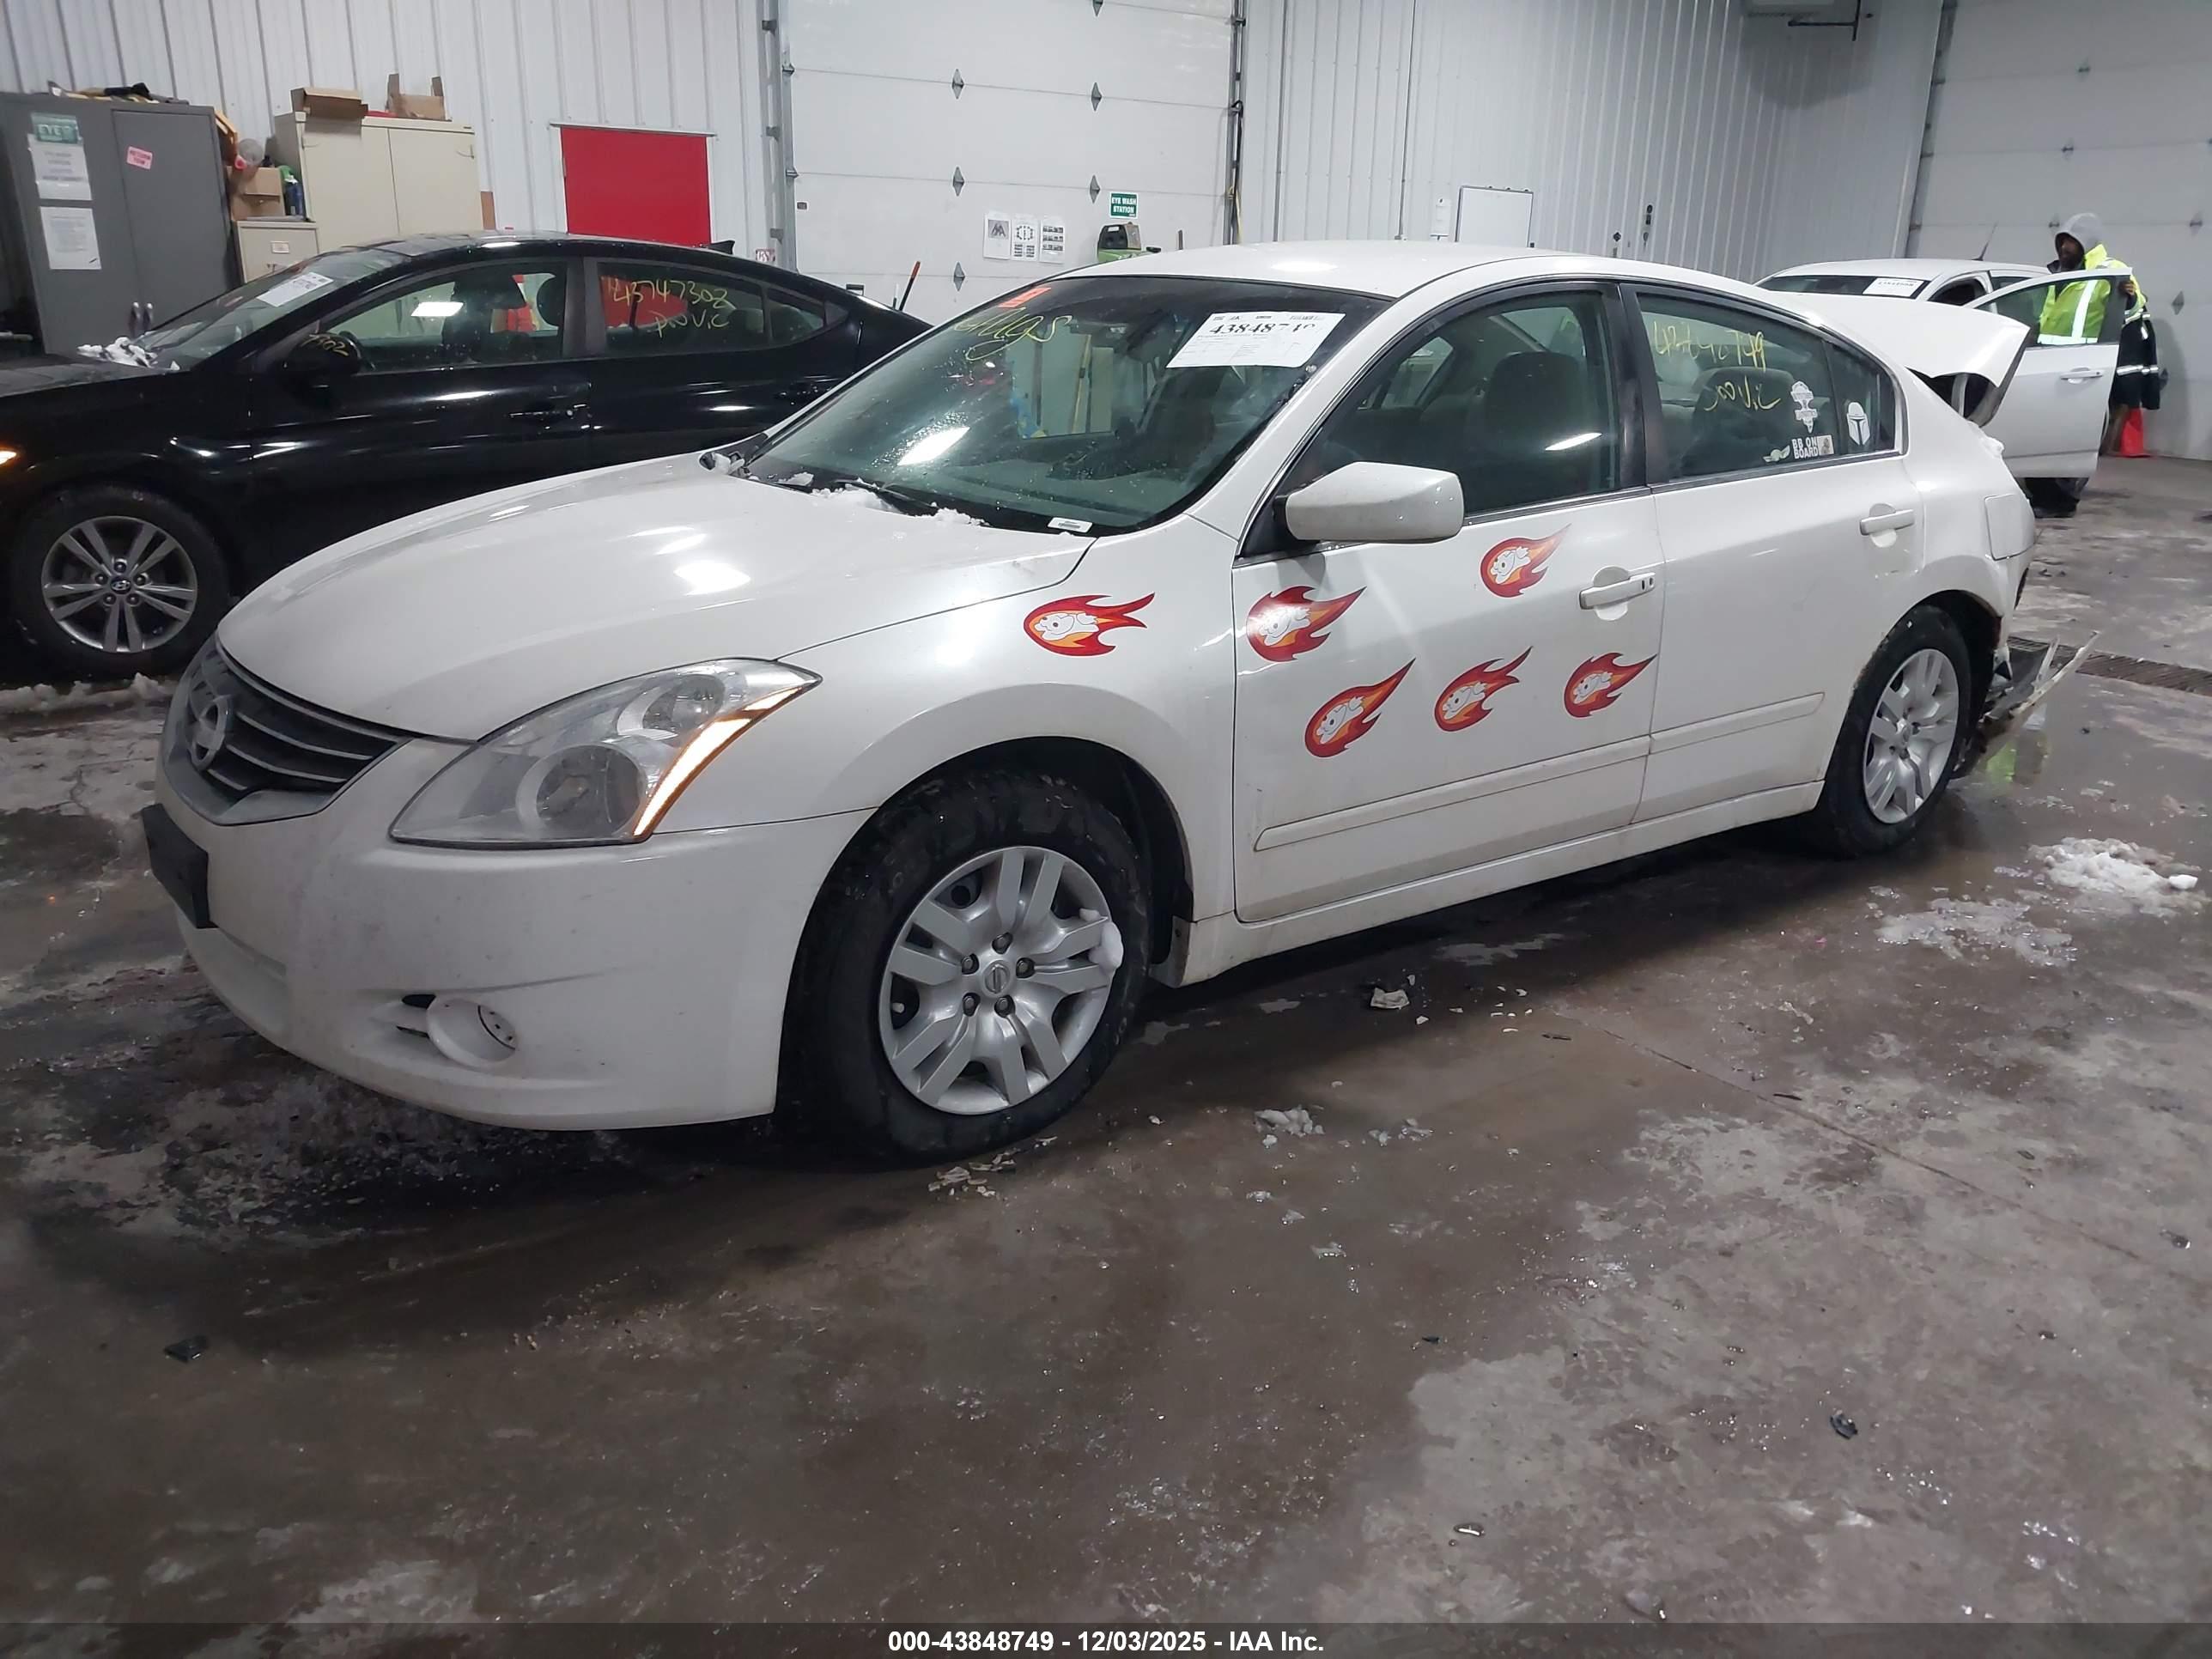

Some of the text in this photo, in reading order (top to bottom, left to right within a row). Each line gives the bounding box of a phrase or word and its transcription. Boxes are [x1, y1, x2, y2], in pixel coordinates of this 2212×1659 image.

[1121, 197, 1137, 205] WASH
[1113, 205, 1134, 214] STATION
[1791, 436, 1818, 448] BB ON
[1793, 447, 1819, 459] BOARD
